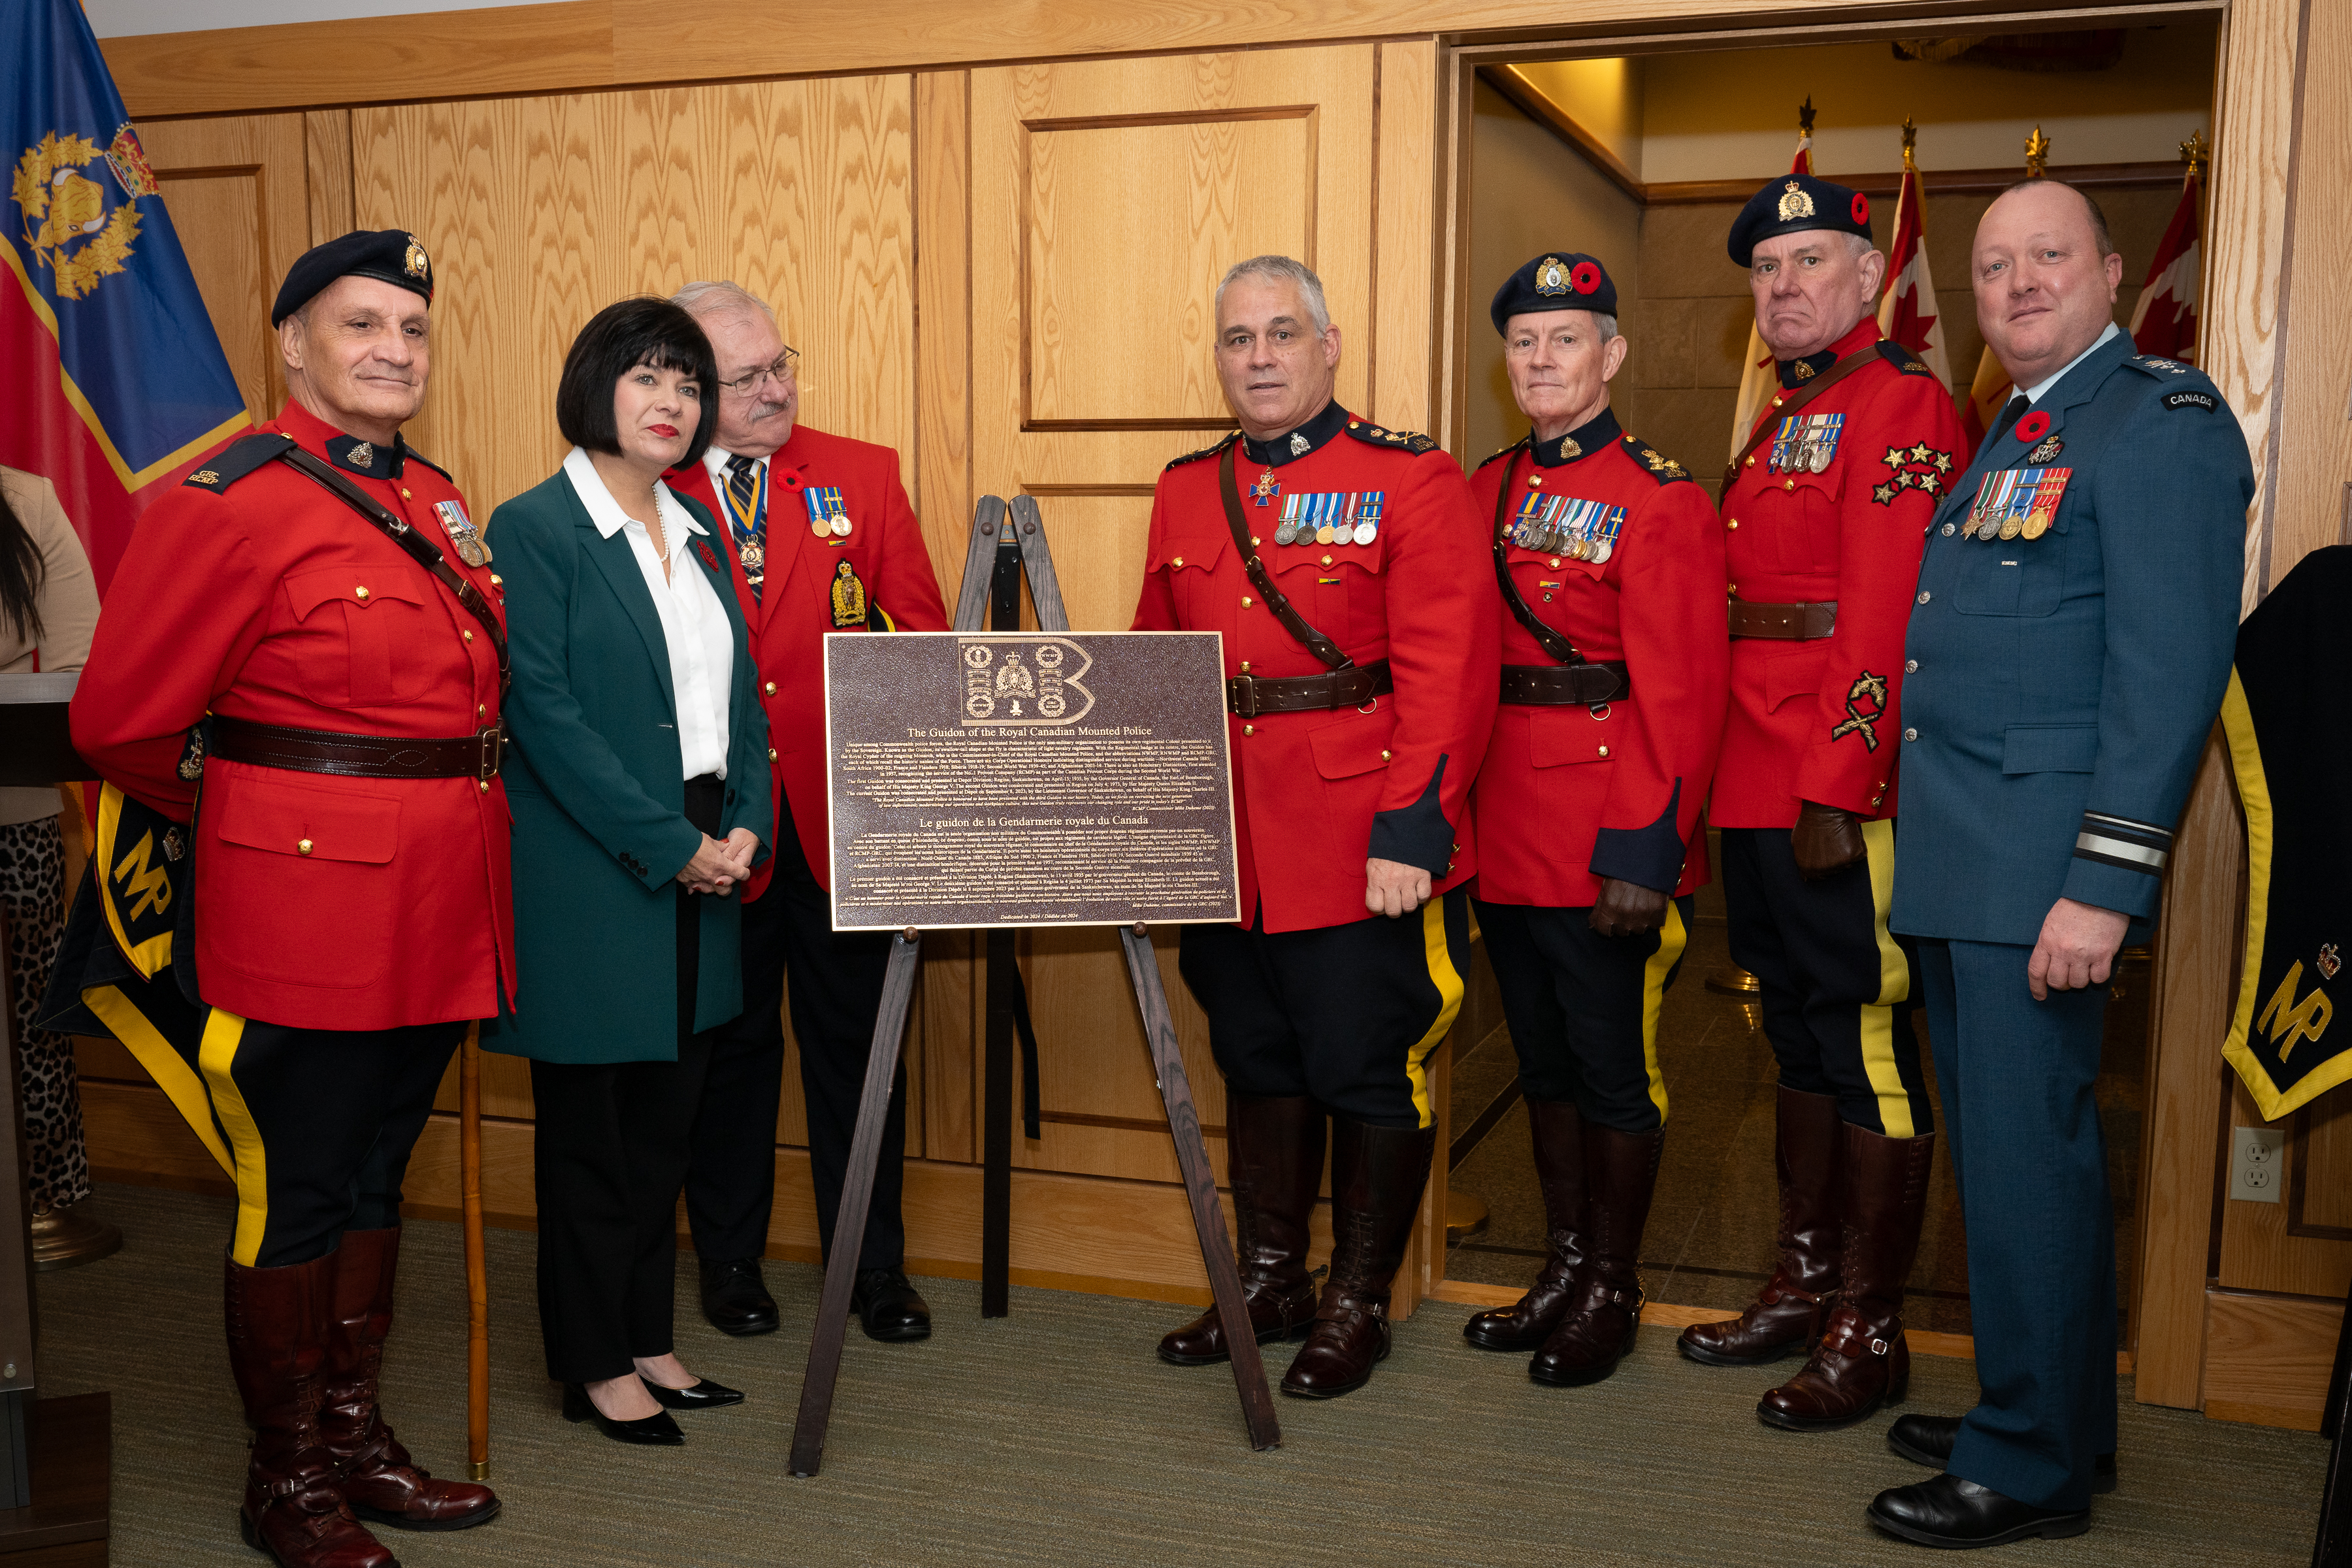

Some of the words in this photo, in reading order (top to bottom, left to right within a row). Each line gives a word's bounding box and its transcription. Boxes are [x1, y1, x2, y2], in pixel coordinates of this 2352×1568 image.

[2170, 394, 2212, 408] CANADA
[188, 474, 218, 484] RCMP
[907, 728, 925, 737] The
[929, 728, 964, 737] Guidon
[968, 728, 977, 736] of
[981, 727, 995, 736] the
[999, 727, 1026, 739] Royal
[1030, 727, 1074, 736] Canadian
[1078, 727, 1120, 736] Mounted
[1123, 726, 1152, 735] Police
[919, 818, 932, 827] Le
[936, 817, 969, 830] guidon
[972, 817, 983, 826] de
[987, 817, 995, 826] la
[999, 816, 1062, 826] Gendarmerie
[1065, 815, 1094, 828] royale
[1098, 815, 1109, 825] du
[1113, 815, 1149, 825] Canada
[114, 827, 172, 923] MP
[2257, 959, 2333, 1063] MP
